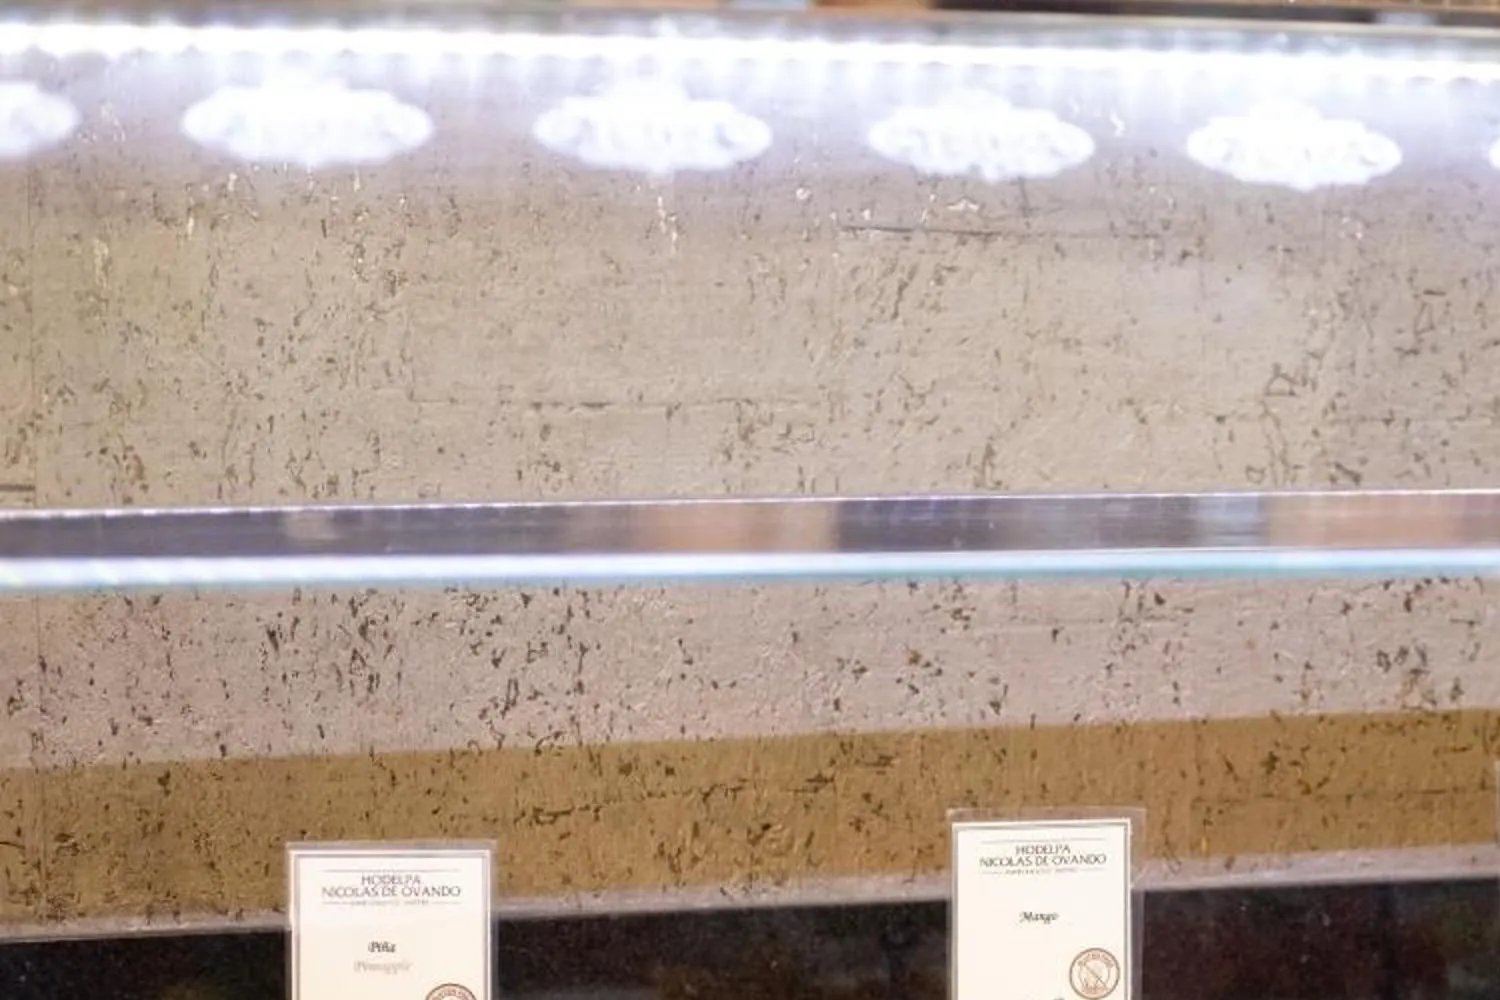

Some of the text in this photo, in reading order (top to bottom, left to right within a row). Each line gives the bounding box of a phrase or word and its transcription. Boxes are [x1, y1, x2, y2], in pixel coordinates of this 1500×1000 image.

[1015, 844, 1071, 855] HODELPA
[1035, 855, 1049, 866] DE
[1052, 853, 1107, 865] OVANDO
[361, 874, 421, 885] HODELPA
[381, 886, 397, 897] DE
[401, 885, 461, 897] OVANDO
